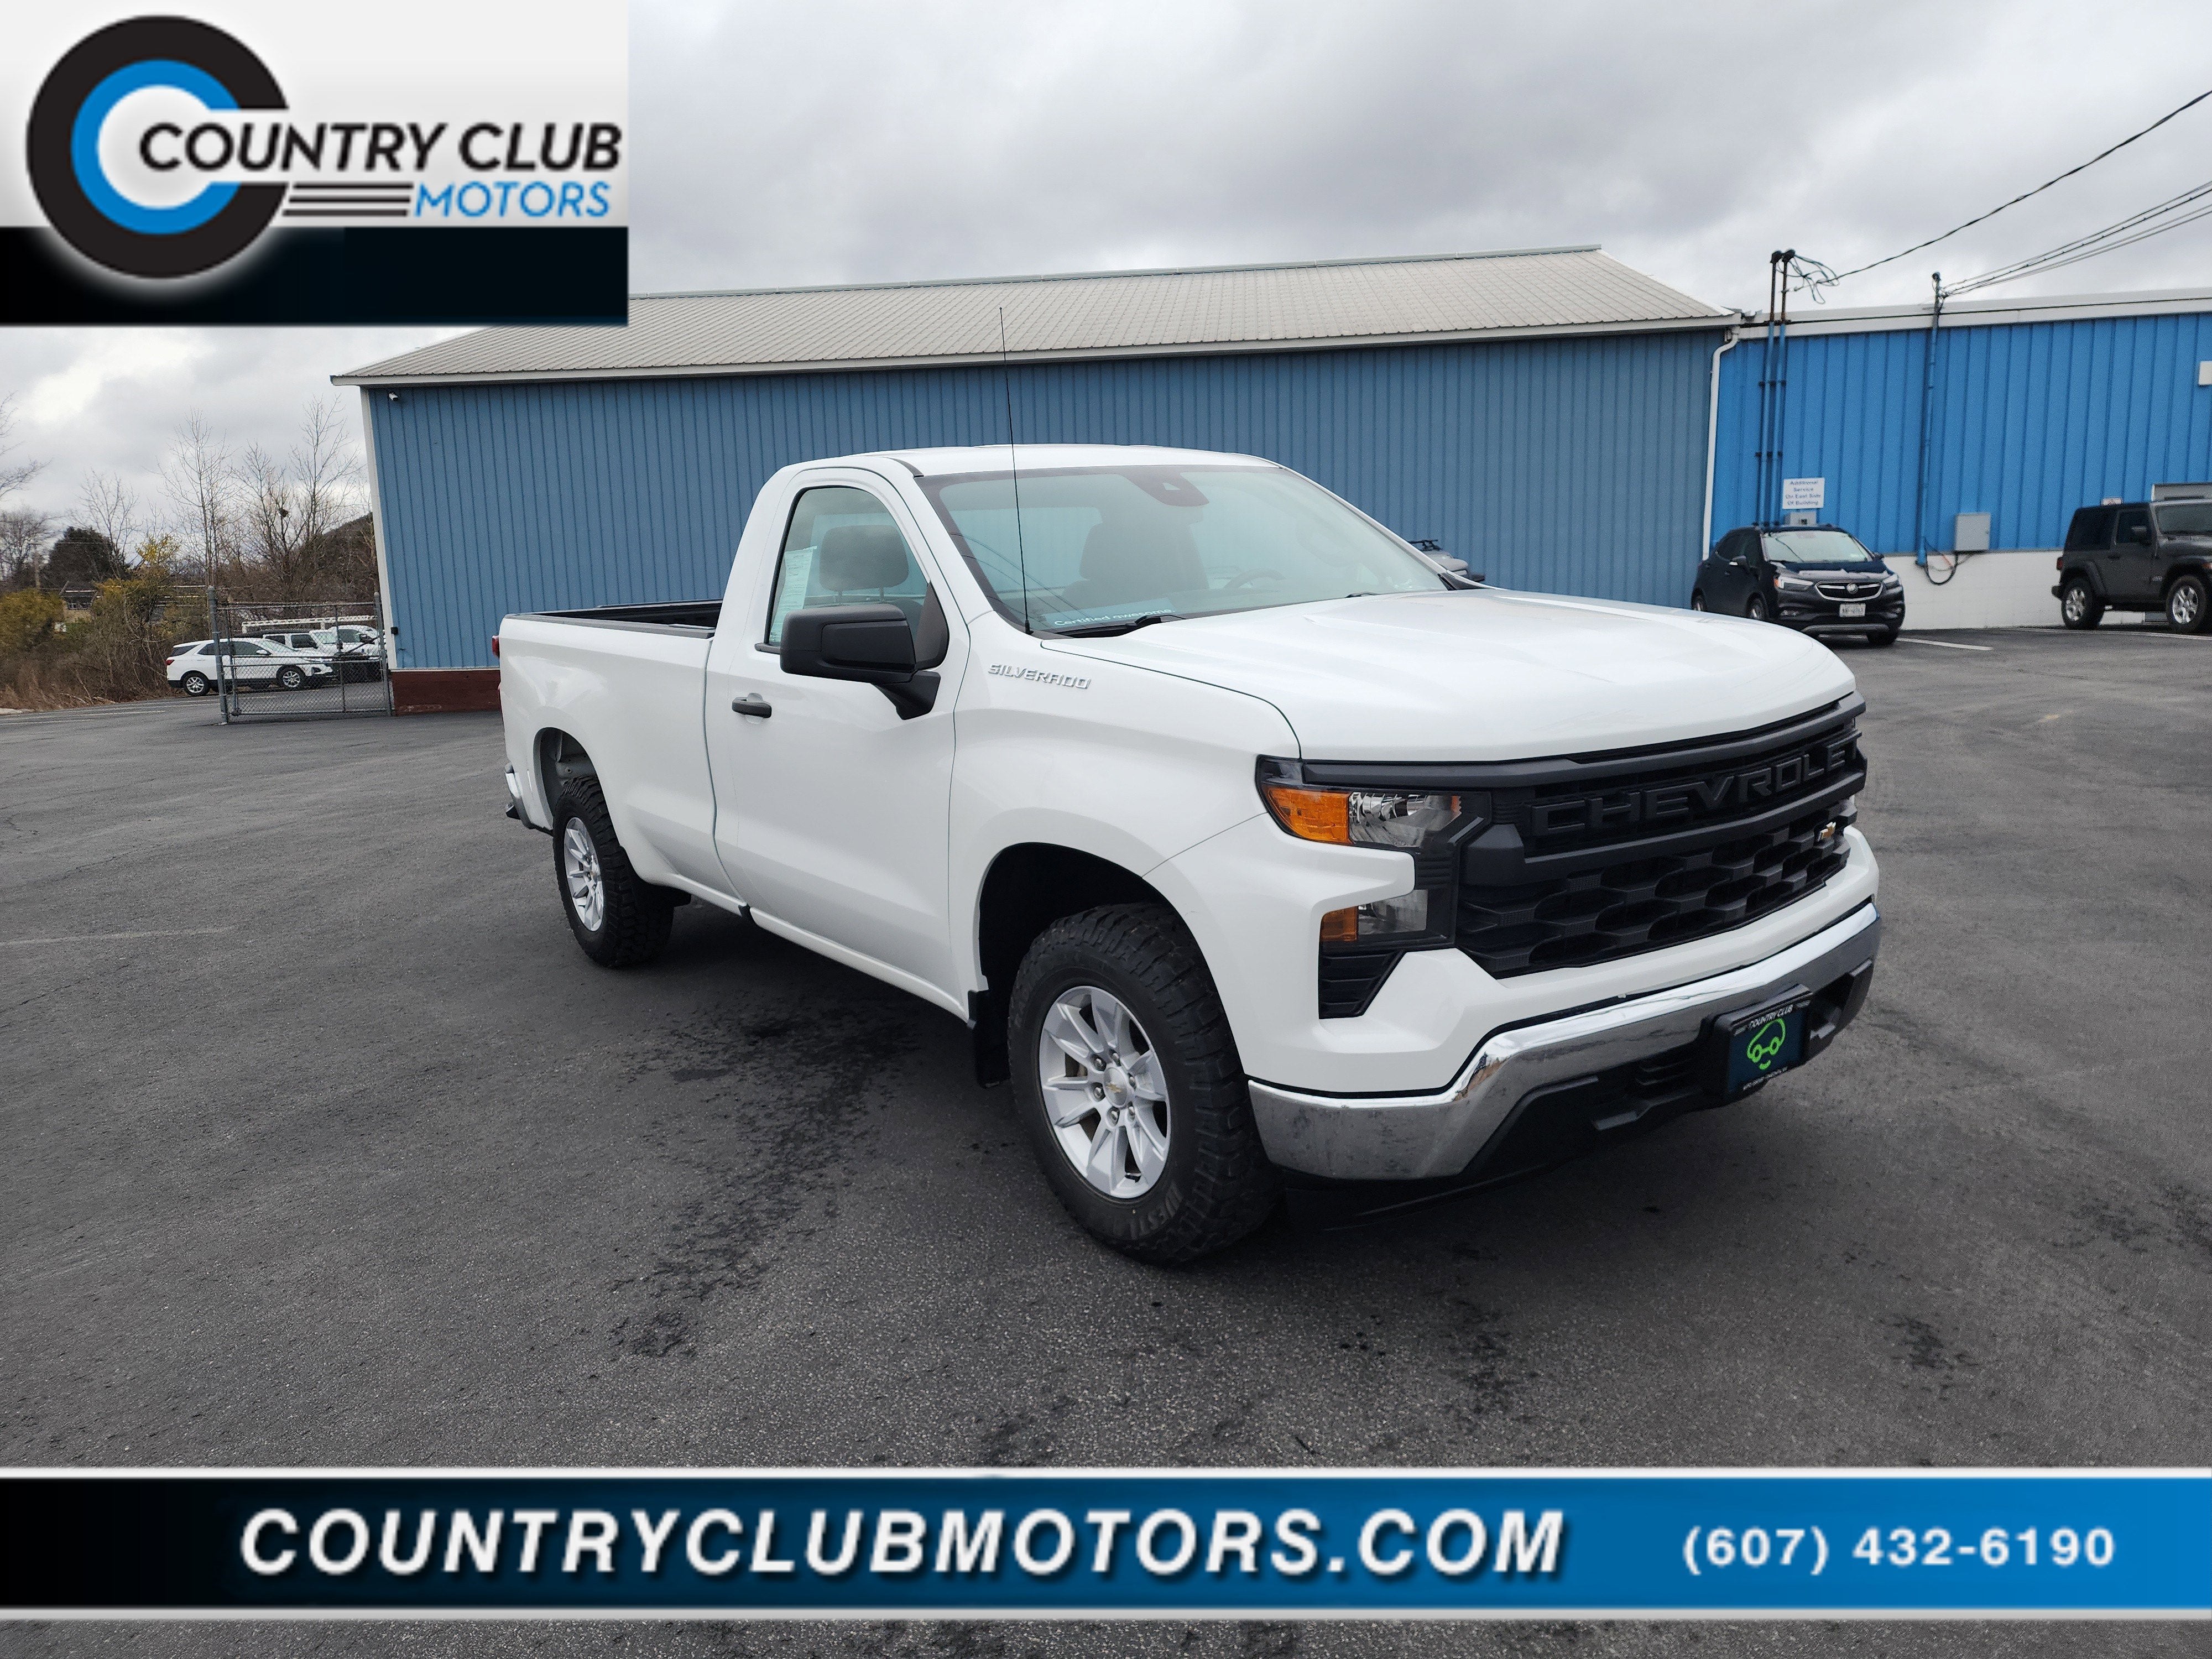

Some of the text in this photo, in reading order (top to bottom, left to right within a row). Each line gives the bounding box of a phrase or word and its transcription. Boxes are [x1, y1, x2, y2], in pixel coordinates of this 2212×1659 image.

[1054, 615, 1110, 626] Certified
[987, 662, 1092, 690] SILVERADO
[1777, 1004, 1793, 1018] CLUB
